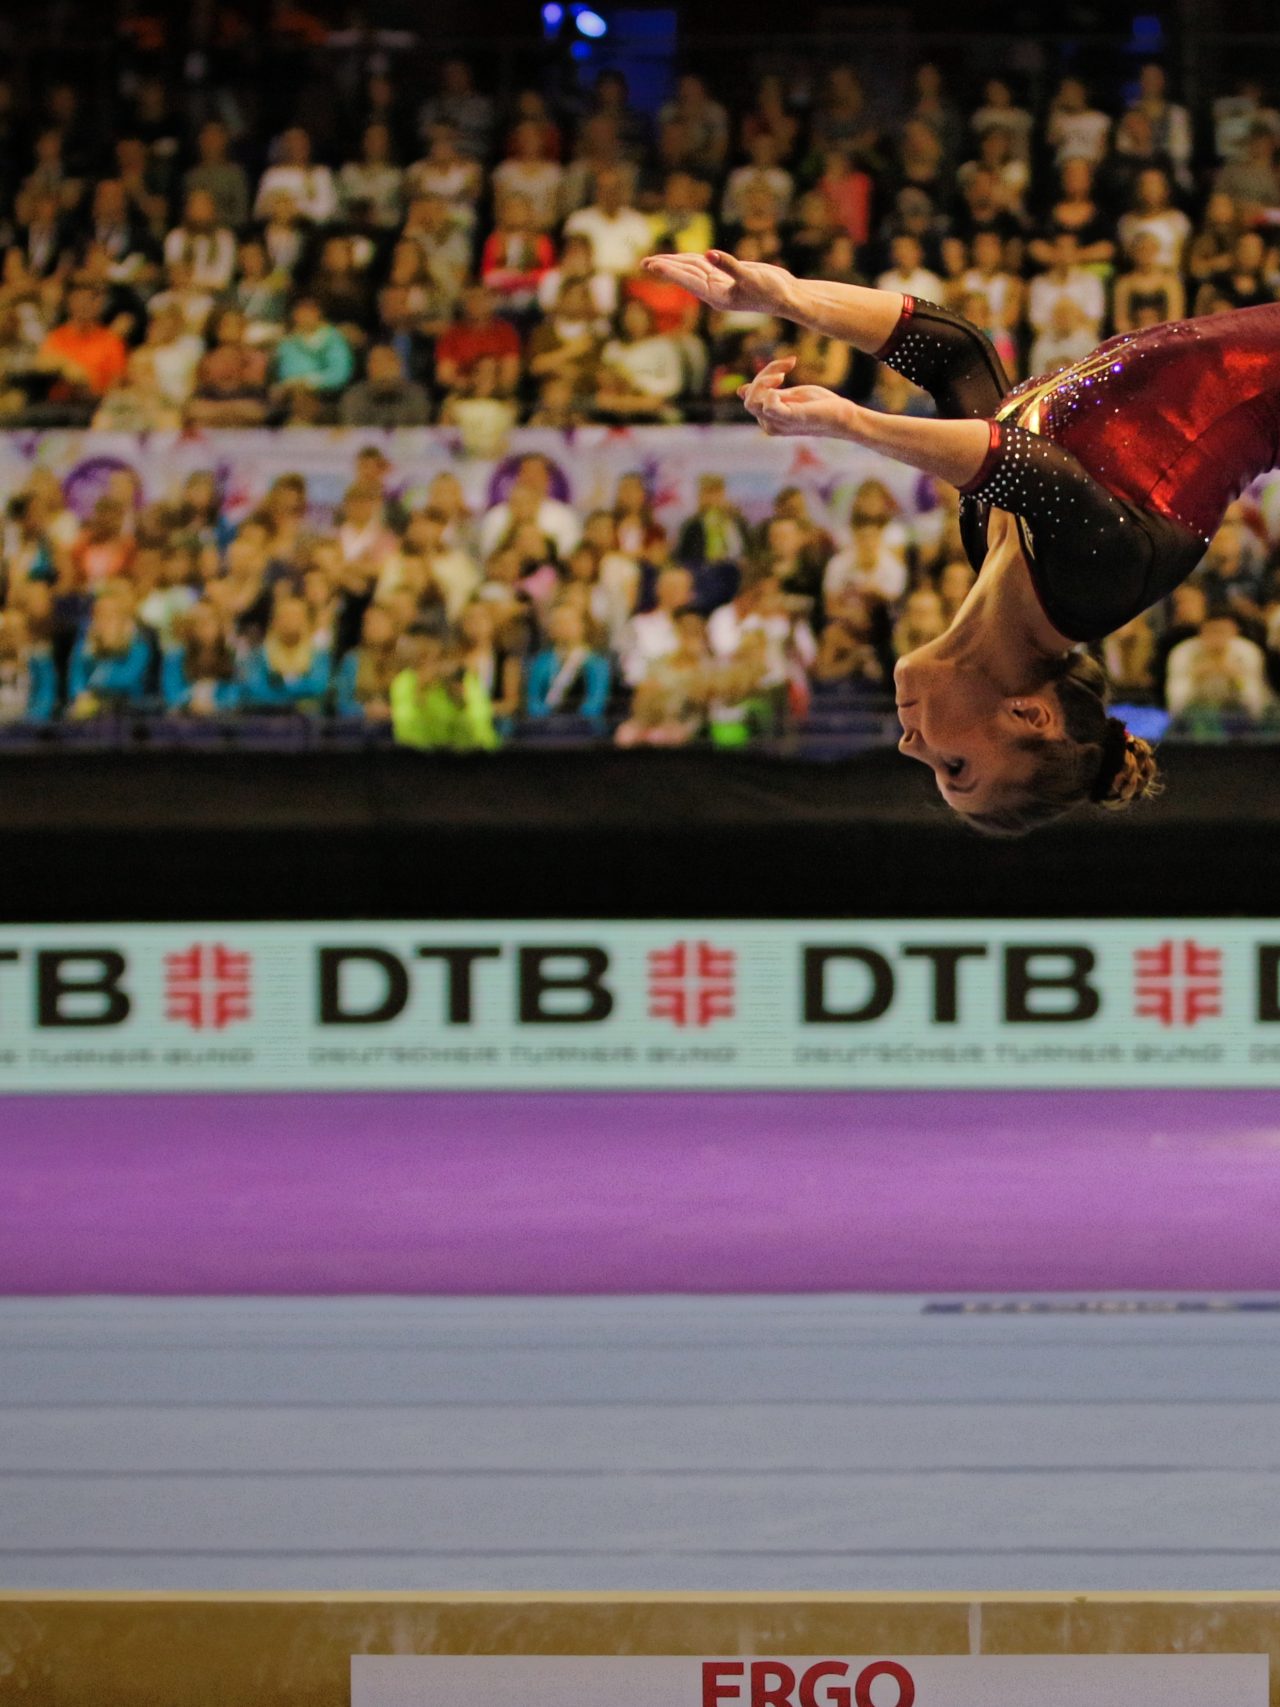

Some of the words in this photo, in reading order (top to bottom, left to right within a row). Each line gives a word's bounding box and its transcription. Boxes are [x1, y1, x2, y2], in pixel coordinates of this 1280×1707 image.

[0, 946, 132, 1028] B
[317, 945, 614, 1026] DTB
[802, 943, 1101, 1024] DTB
[702, 1660, 915, 1707] ERGO
